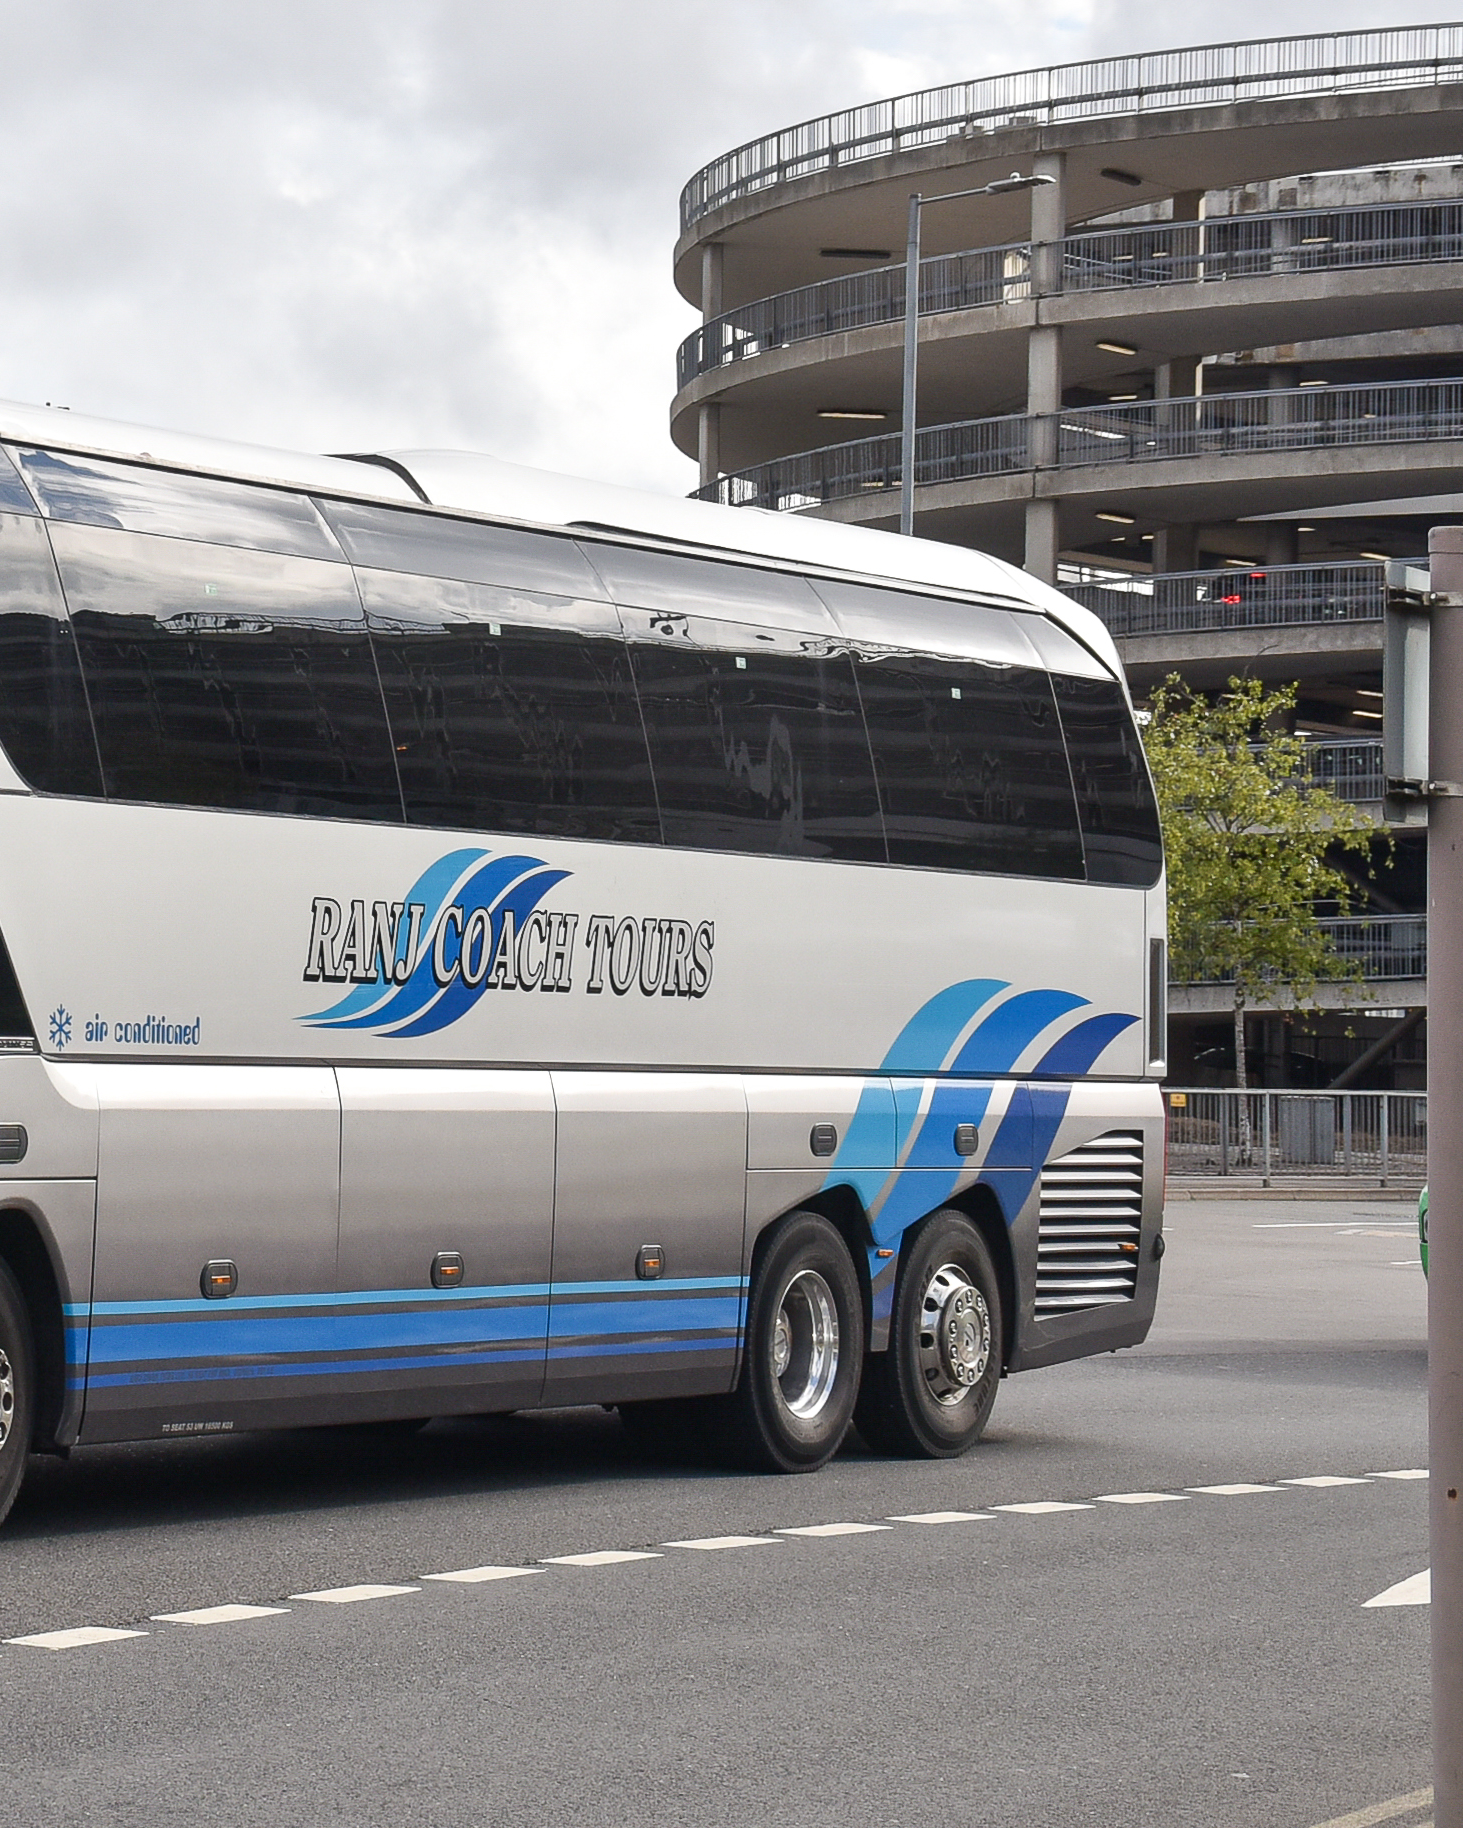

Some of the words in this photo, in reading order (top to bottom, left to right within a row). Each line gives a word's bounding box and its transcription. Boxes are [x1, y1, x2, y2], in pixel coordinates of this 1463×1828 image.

[303, 896, 426, 986] RANJ
[432, 903, 579, 993] COACH
[585, 914, 715, 1000] TOURS
[85, 1012, 108, 1042] air
[114, 1014, 201, 1046] conditioned
